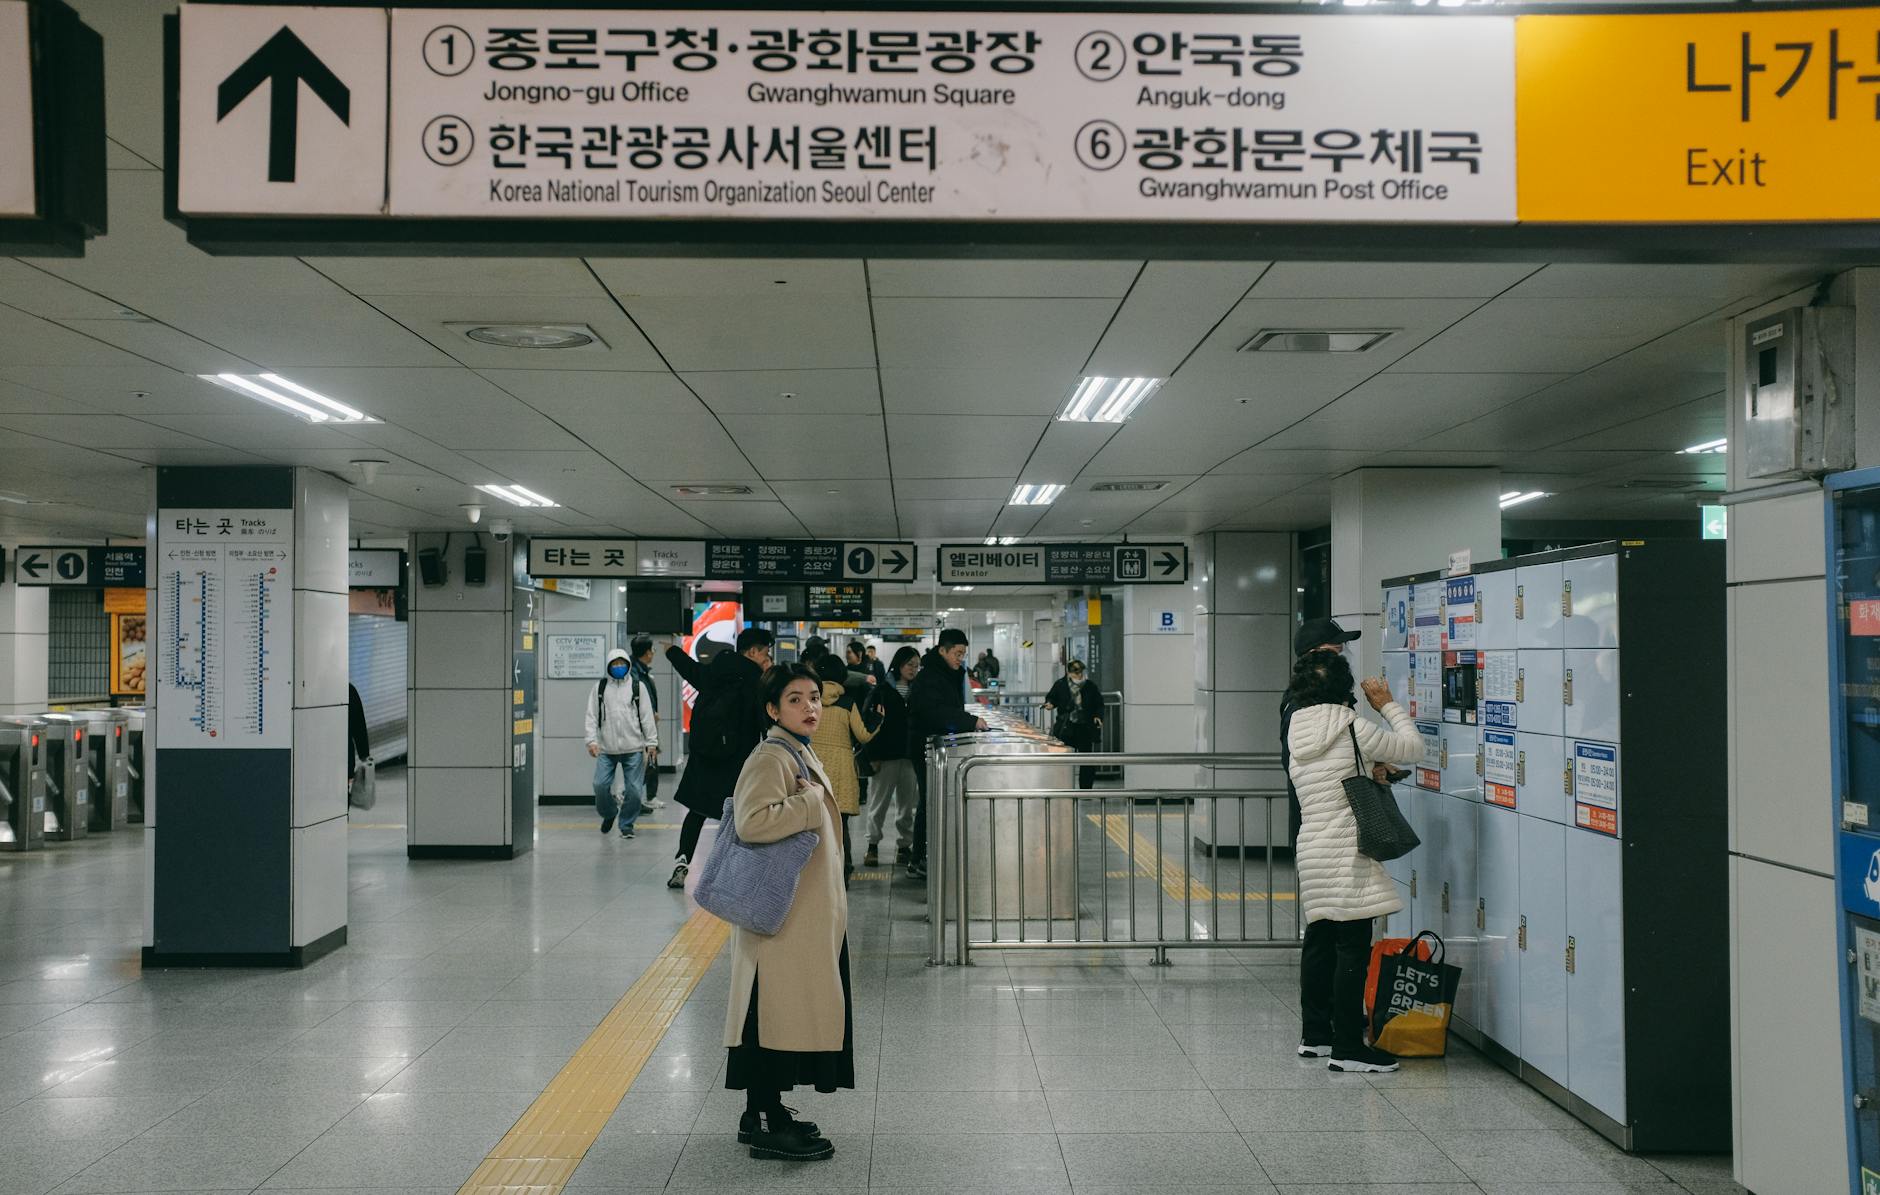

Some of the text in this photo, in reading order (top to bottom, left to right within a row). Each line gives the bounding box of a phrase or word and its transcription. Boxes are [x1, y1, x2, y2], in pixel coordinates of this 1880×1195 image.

[1132, 31, 1304, 78] 안국동
[483, 80, 690, 106] Jongno-gu Office
[746, 82, 1016, 108] Gwanghwamun Square
[1136, 85, 1286, 111] Anguk-dong
[489, 123, 937, 172] 한국관광공사서울센터
[1132, 127, 1482, 175] 광화문우체국
[1687, 147, 1767, 188] Exit
[489, 178, 936, 208] Korea National Tourism Organization Seoul Center
[1138, 176, 1449, 203] Gwanghwamun Post Office
[175, 517, 211, 536] 타는
[215, 518, 235, 536] 곳
[240, 519, 267, 528] Tracks
[544, 547, 625, 568] 타는 곳
[652, 550, 679, 560] Tracks
[803, 561, 833, 571] 소요산
[949, 552, 1040, 568] 엘리베이터
[950, 569, 989, 578] Elevator
[1161, 612, 1175, 627] B
[1393, 979, 1418, 996] GO
[1395, 965, 1439, 988] LET'S
[1391, 993, 1445, 1019] GREEN
